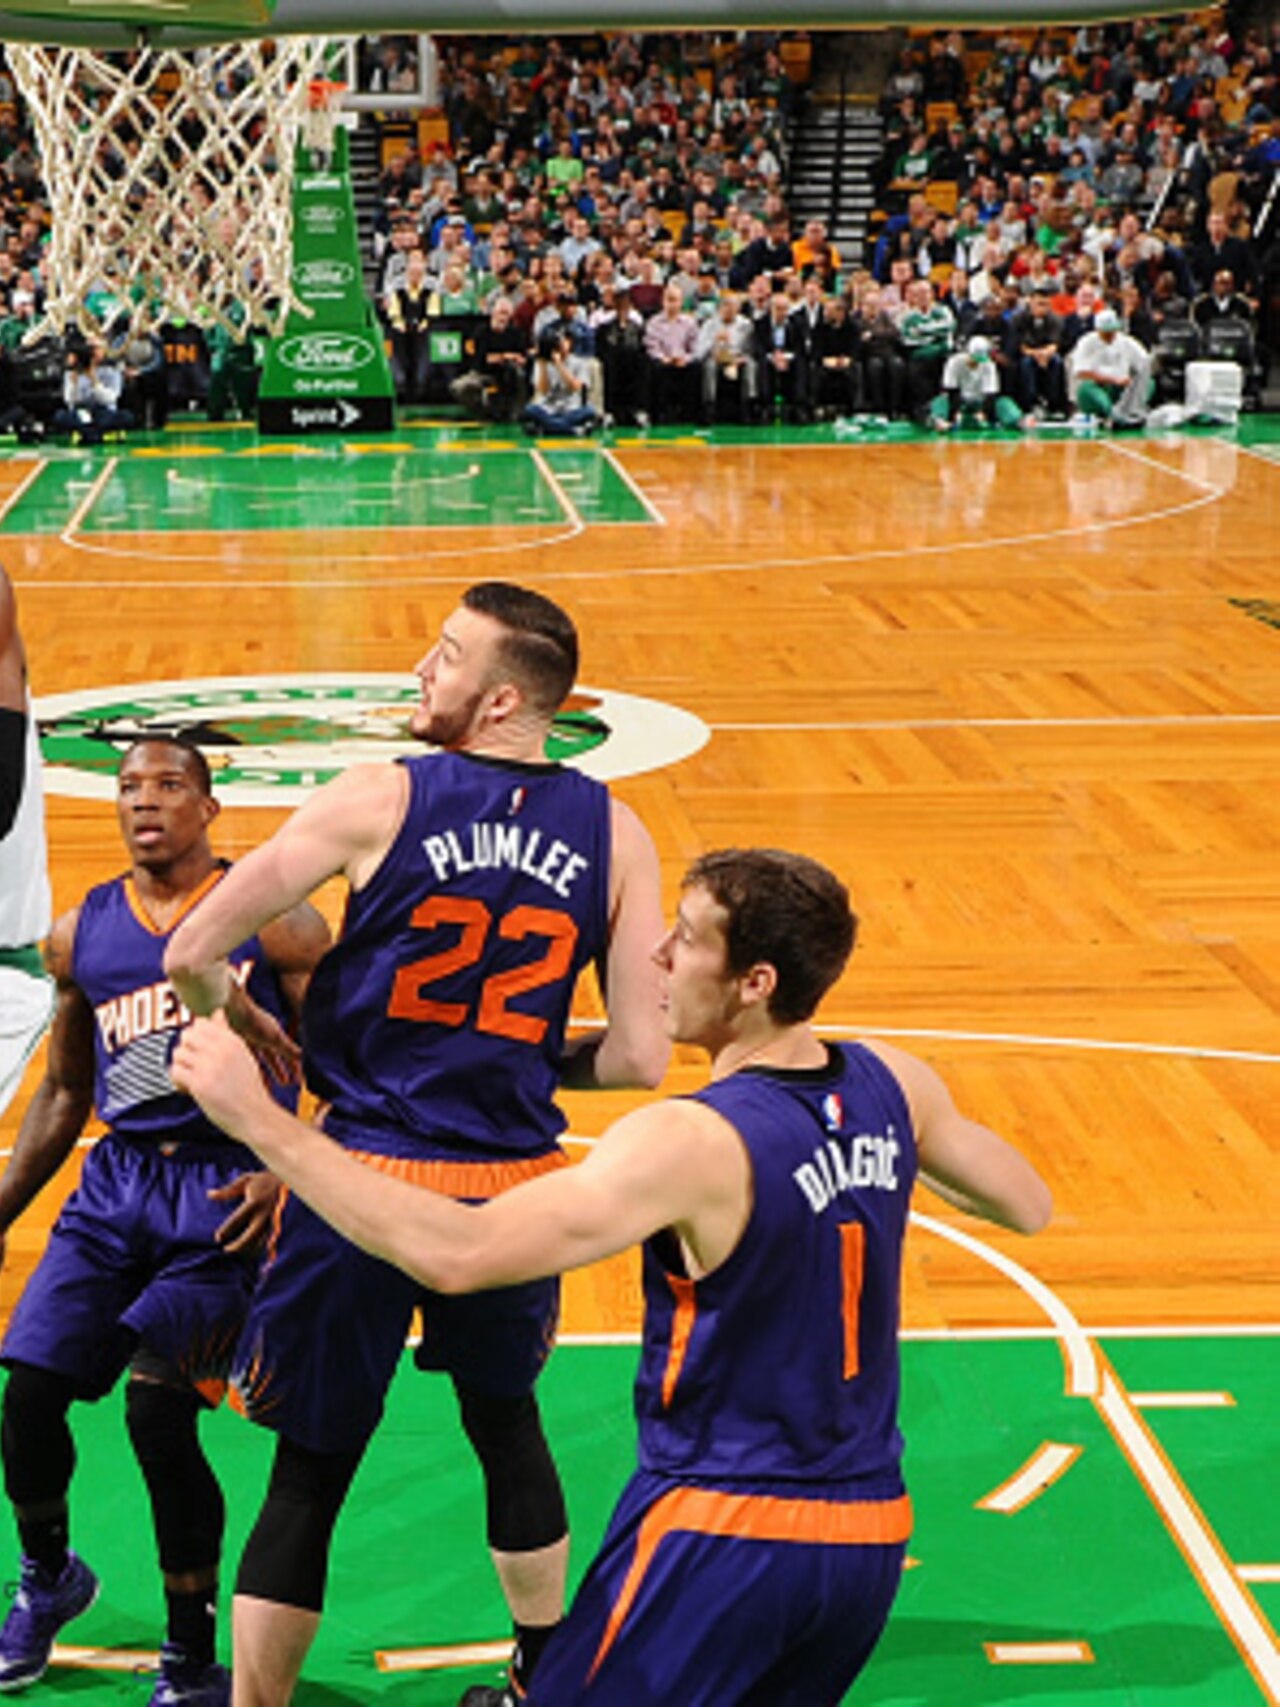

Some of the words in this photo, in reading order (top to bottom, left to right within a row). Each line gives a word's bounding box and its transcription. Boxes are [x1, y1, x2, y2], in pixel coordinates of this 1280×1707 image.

[290, 337, 361, 369] Ford
[423, 822, 588, 897] PLUMLEE
[387, 895, 579, 1045] 22
[836, 1219, 866, 1381] 1
